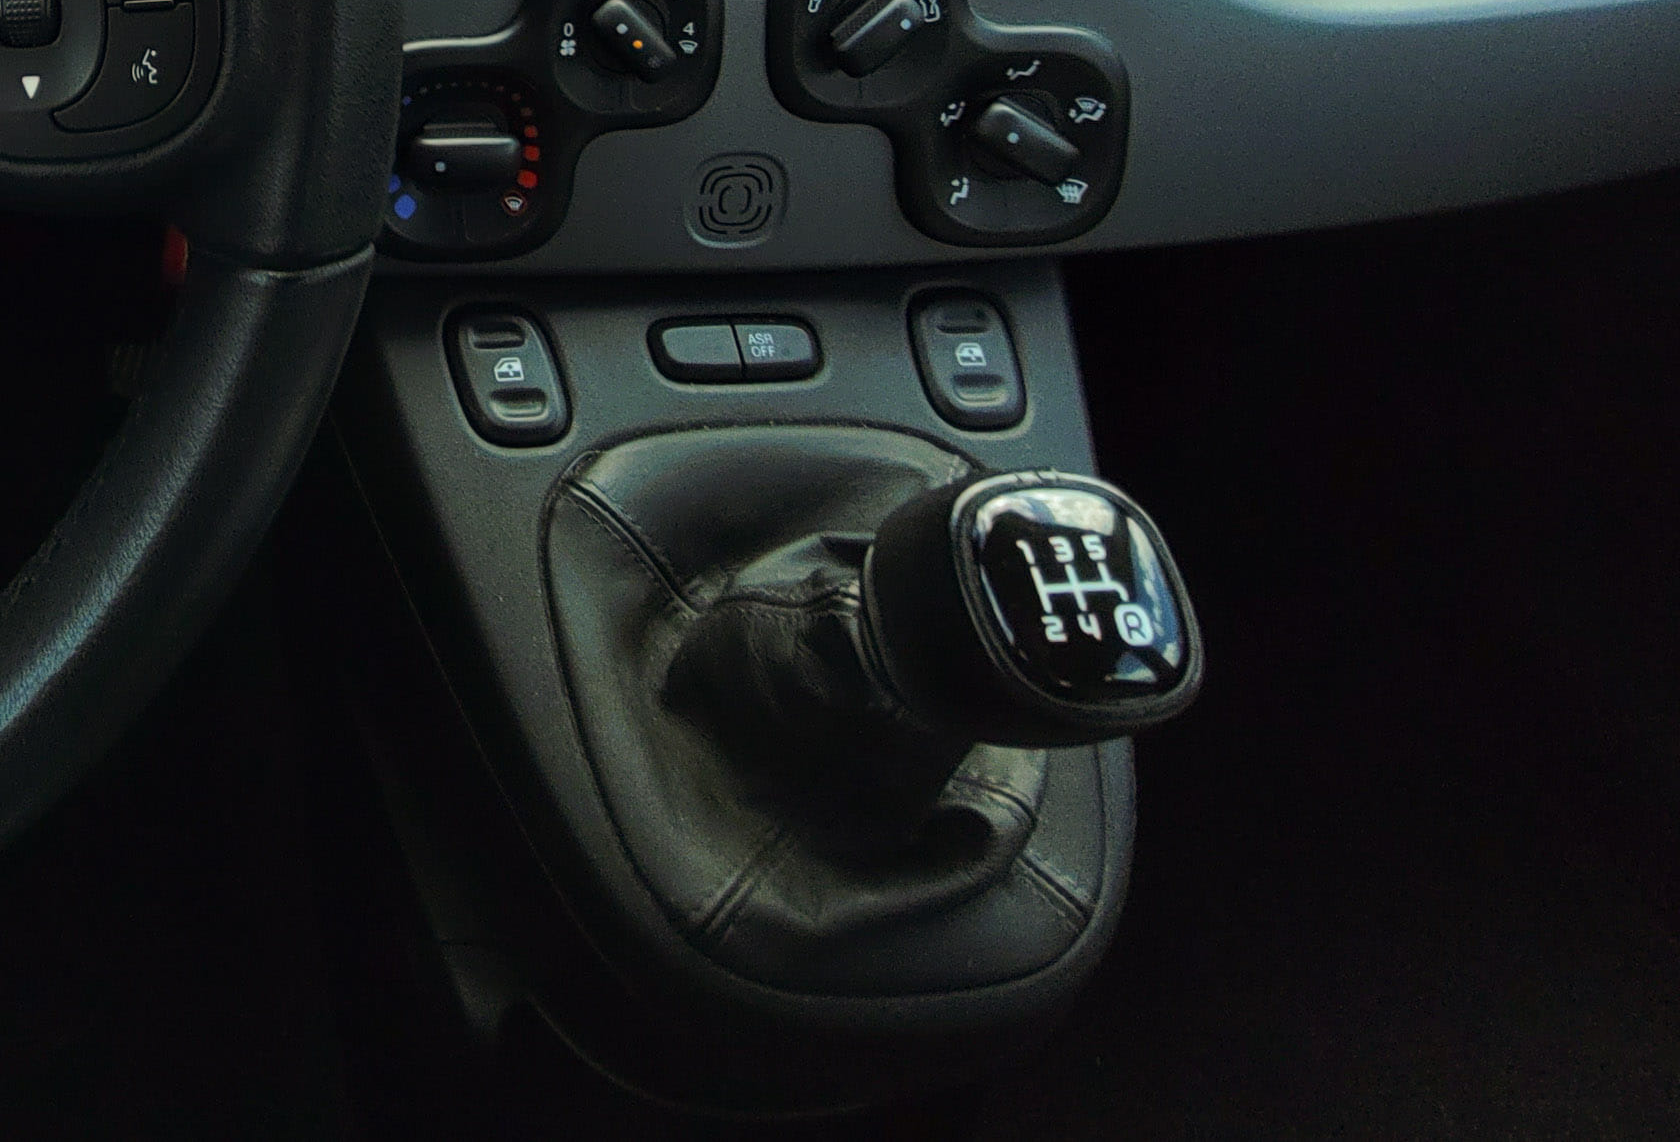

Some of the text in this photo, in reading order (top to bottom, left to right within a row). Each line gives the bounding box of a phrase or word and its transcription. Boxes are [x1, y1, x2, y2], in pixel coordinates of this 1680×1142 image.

[682, 21, 695, 36] 4
[748, 332, 775, 345] ASR
[751, 345, 776, 358] OFF
[1015, 539, 1036, 565] 1
[1048, 535, 1075, 563] 3
[1081, 534, 1108, 561] 5
[1041, 615, 1069, 643] 2
[1076, 613, 1102, 642] 4
